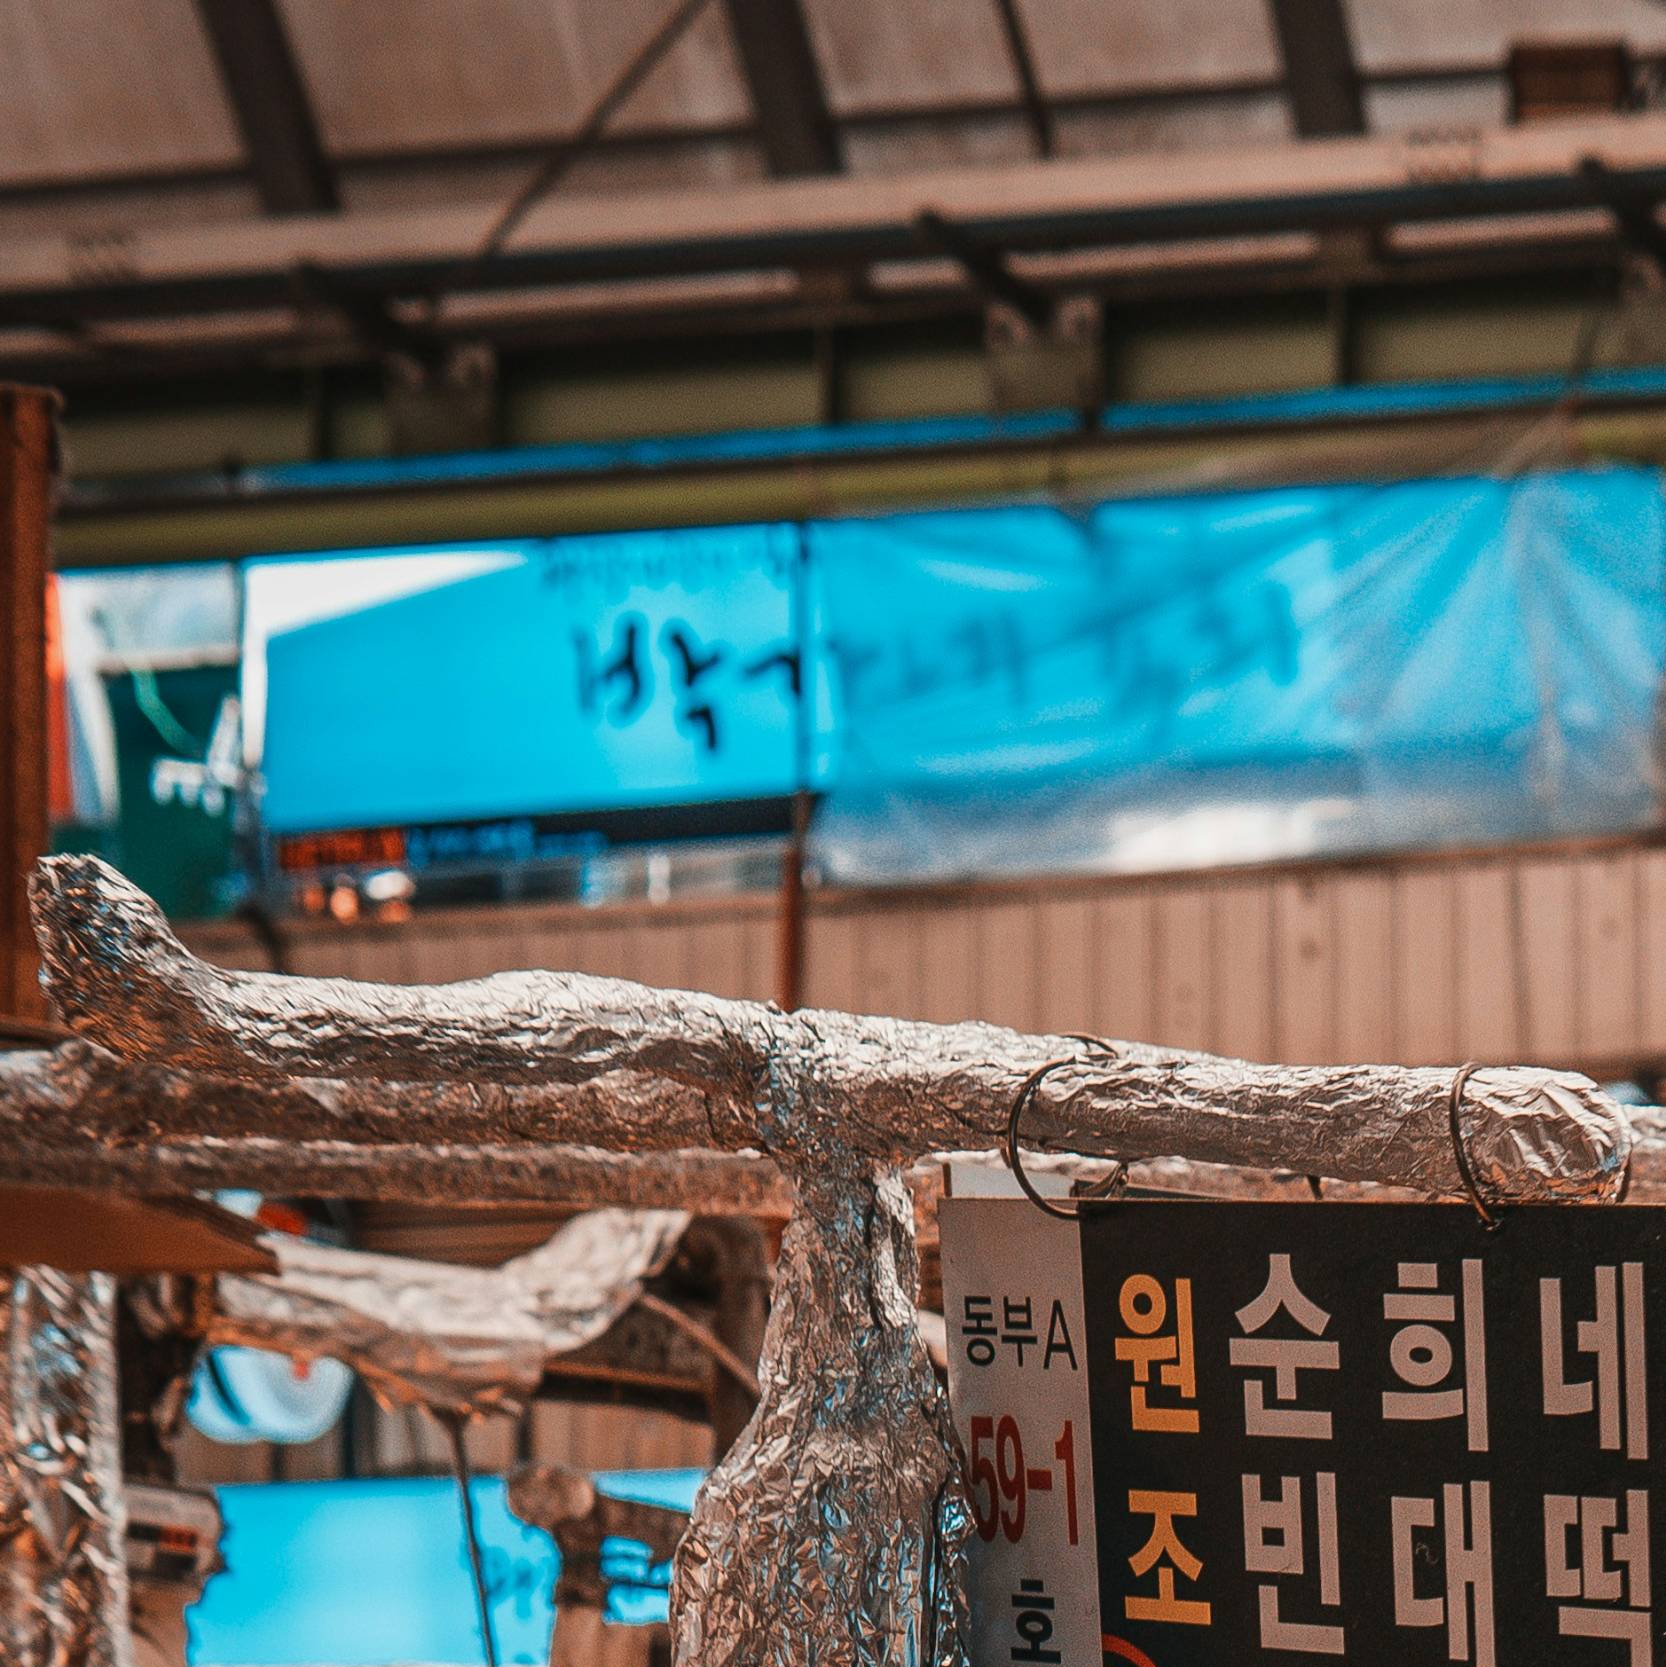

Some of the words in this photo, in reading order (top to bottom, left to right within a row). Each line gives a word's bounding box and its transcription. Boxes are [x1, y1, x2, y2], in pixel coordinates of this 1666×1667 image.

[962, 1295, 1078, 1371] 동부A
[1229, 1250, 1649, 1460] 순희네
[967, 1414, 1080, 1546] 59-1
[1114, 1274, 1211, 1626] 원조
[1011, 1578, 1062, 1664] 호
